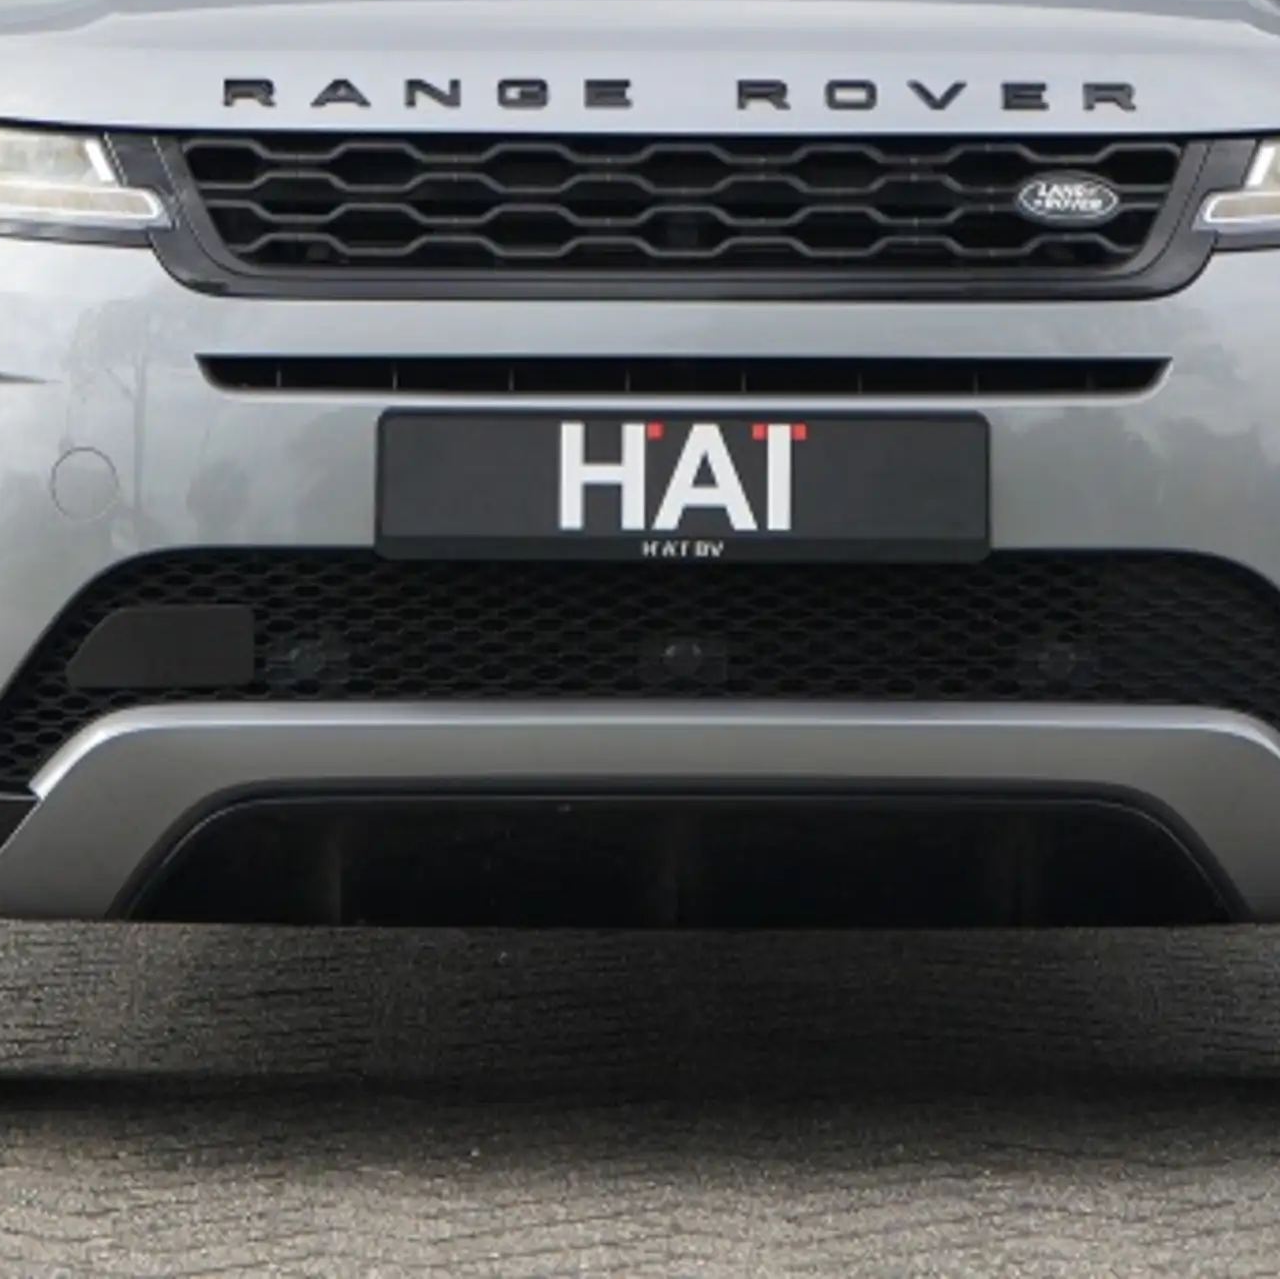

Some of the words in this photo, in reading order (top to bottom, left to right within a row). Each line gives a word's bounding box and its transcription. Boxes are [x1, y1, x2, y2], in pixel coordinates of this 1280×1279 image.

[222, 77, 633, 110] RANGE
[736, 78, 1138, 112] ROVER
[1036, 181, 1084, 198] LAND
[1044, 198, 1104, 213] ROVER
